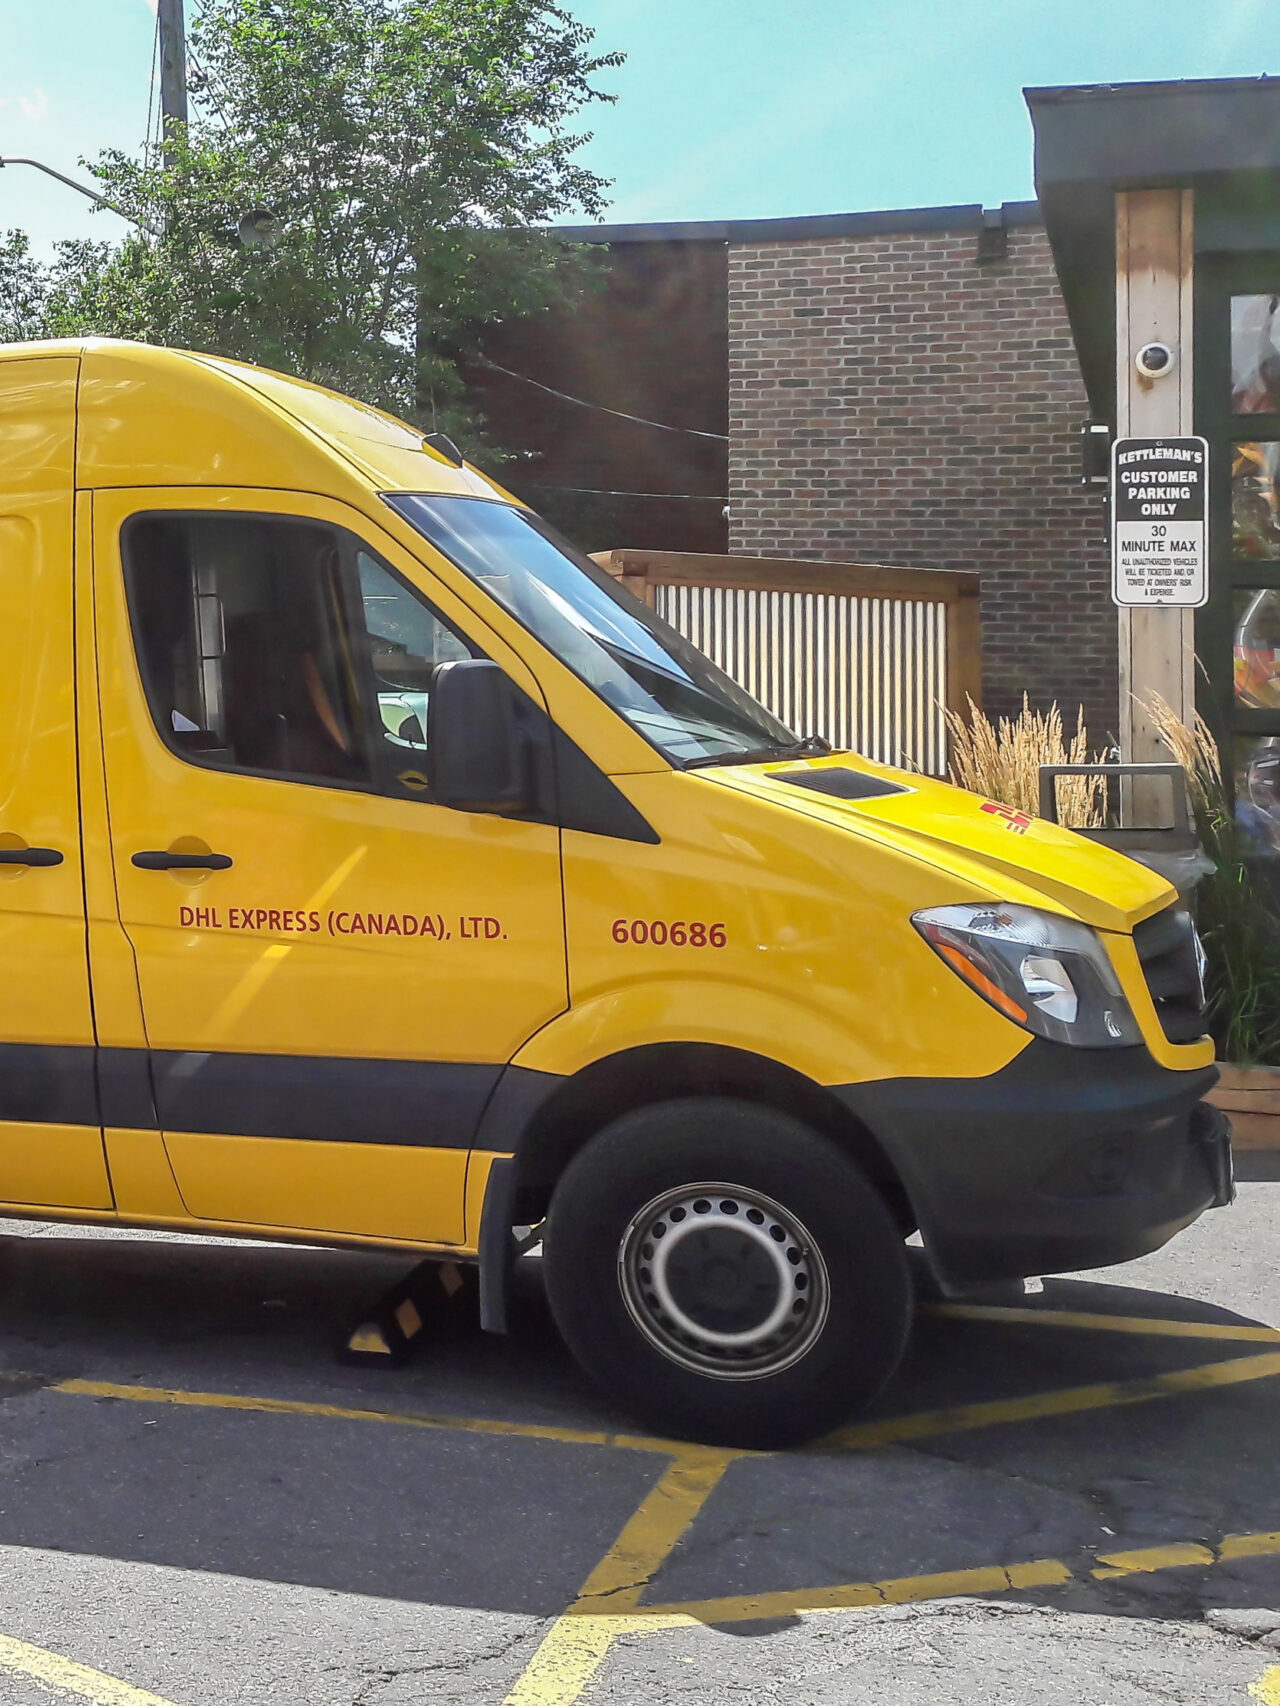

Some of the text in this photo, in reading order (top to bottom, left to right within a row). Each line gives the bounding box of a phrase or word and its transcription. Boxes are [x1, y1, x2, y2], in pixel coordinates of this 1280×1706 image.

[1119, 448, 1203, 465] KETTLEMAN'S
[1121, 471, 1198, 484] CUSTOMER
[1128, 487, 1191, 499] PARKING
[1141, 503, 1177, 515] ONLY
[1151, 525, 1167, 537] 30
[1121, 540, 1197, 552] MINUTE MAX
[179, 906, 508, 941] DHL EXPRESS (CANADA), LTD.
[612, 919, 727, 948] 600686
